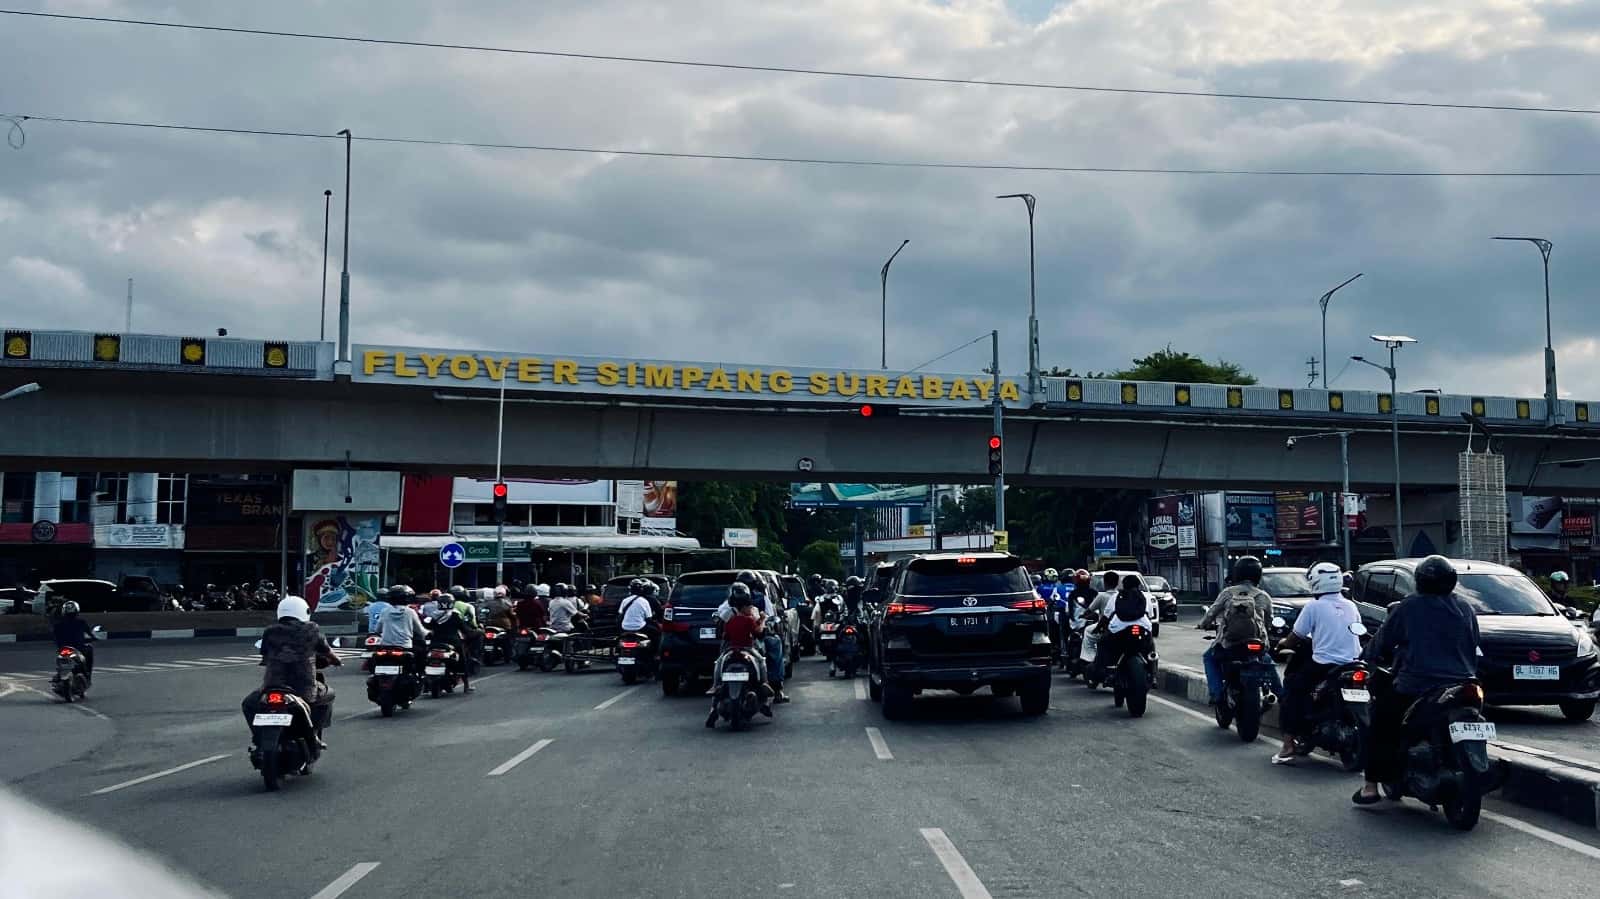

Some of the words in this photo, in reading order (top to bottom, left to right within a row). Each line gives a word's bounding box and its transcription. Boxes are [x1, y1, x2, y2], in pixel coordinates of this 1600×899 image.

[363, 350, 580, 385] FLYOVER
[596, 361, 794, 394] SIMPANG
[807, 370, 1020, 401] SURABAYA
[468, 545, 490, 554] Grab
